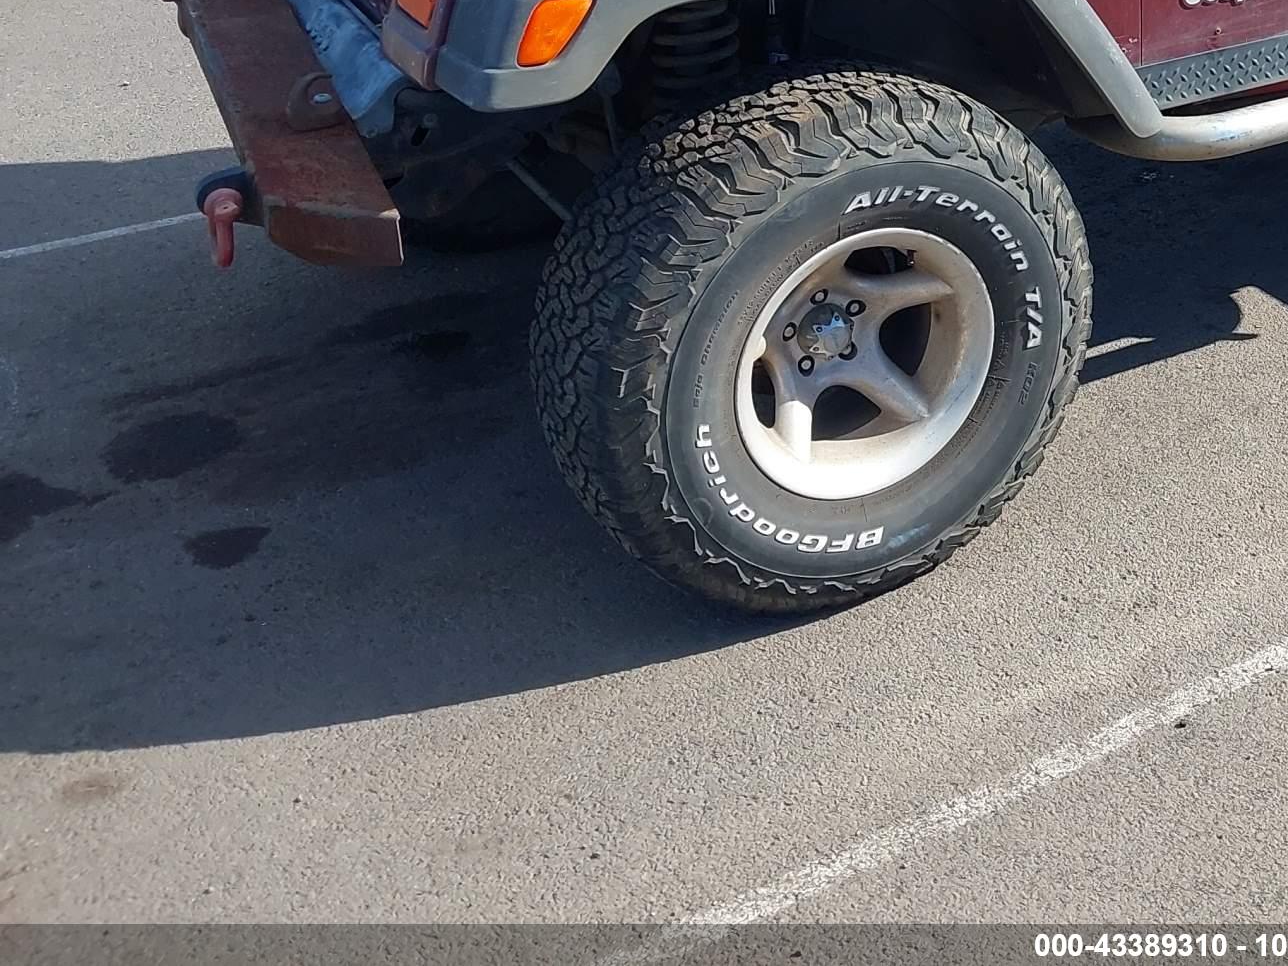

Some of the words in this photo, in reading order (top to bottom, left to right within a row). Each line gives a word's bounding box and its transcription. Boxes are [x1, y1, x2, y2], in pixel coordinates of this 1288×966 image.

[843, 185, 1030, 272] All-Terrain
[1023, 286, 1045, 350] T/A
[695, 424, 885, 553] BFGoodrich
